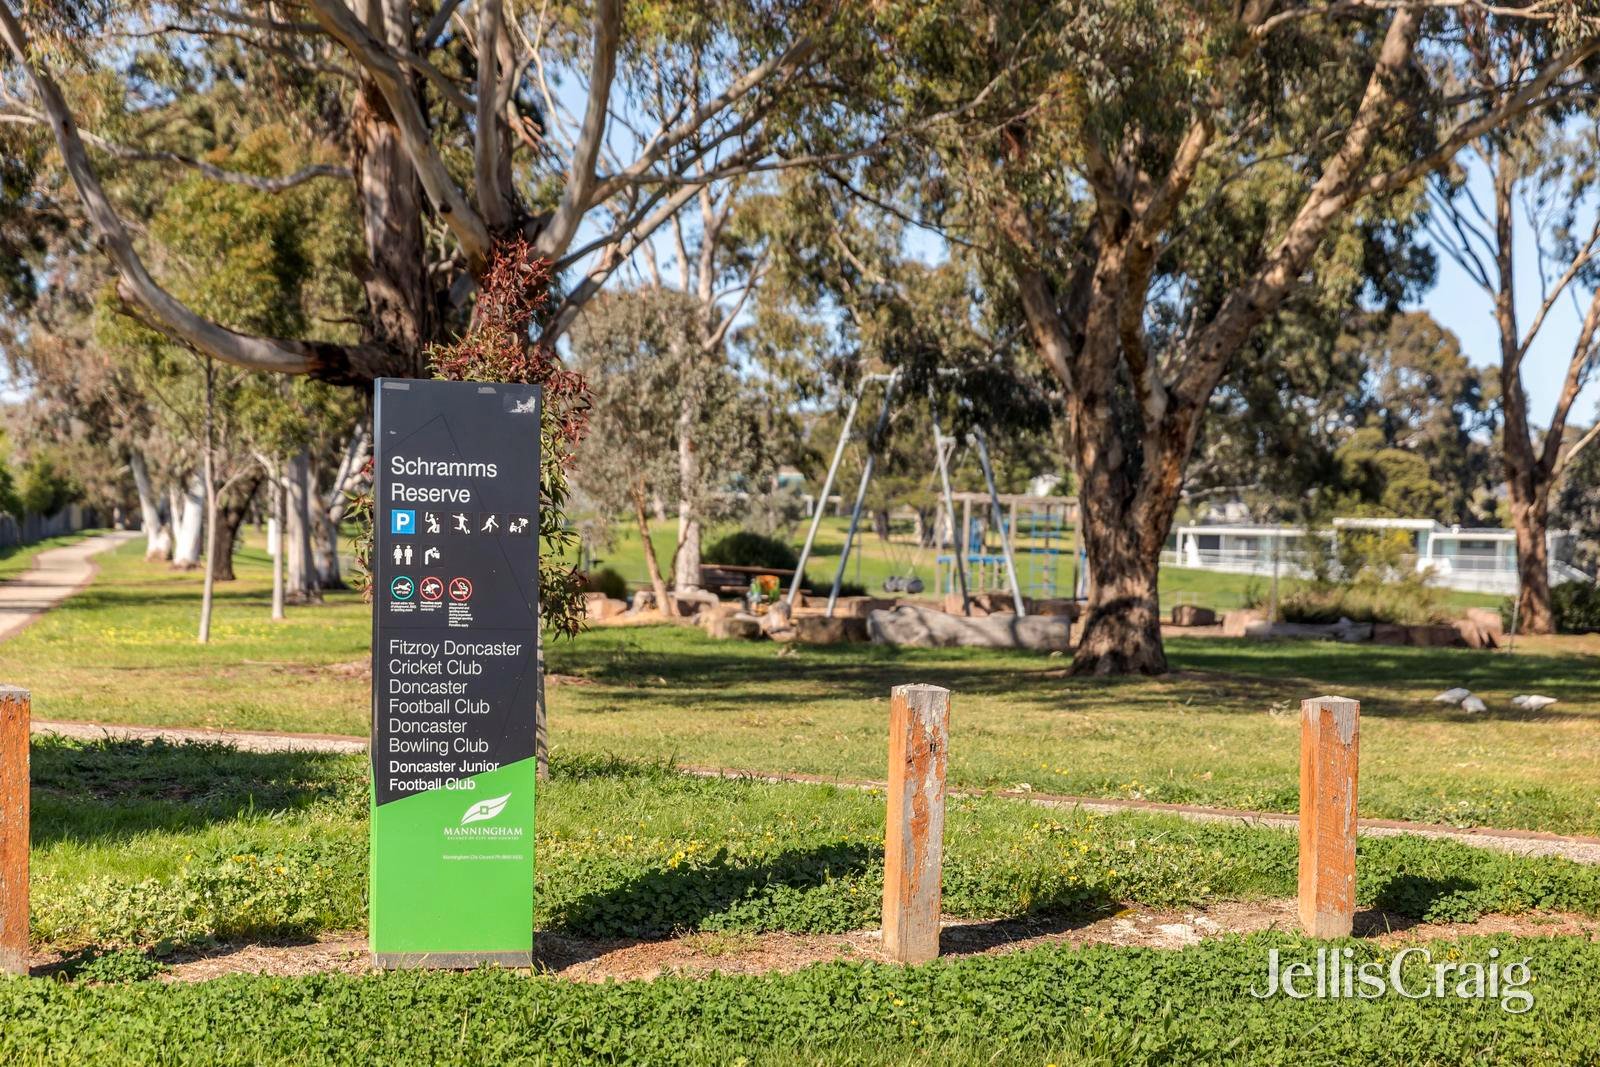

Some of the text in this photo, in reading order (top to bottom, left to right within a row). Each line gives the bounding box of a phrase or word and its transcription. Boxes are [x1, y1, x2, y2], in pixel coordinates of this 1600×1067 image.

[391, 455, 498, 478] Schramms
[391, 483, 471, 503] Reserve
[396, 512, 410, 531] P
[389, 639, 522, 659] Fitzroy Doncaster
[389, 659, 483, 675] Cricket Club
[389, 679, 468, 694] Doncaster
[389, 698, 490, 714] Football Club
[389, 718, 468, 733] Doncaster
[389, 737, 489, 756] Bowling Club
[389, 760, 500, 773] Doncaster Junior
[389, 778, 476, 791] Football Club
[443, 827, 523, 836] MANNINGHAM
